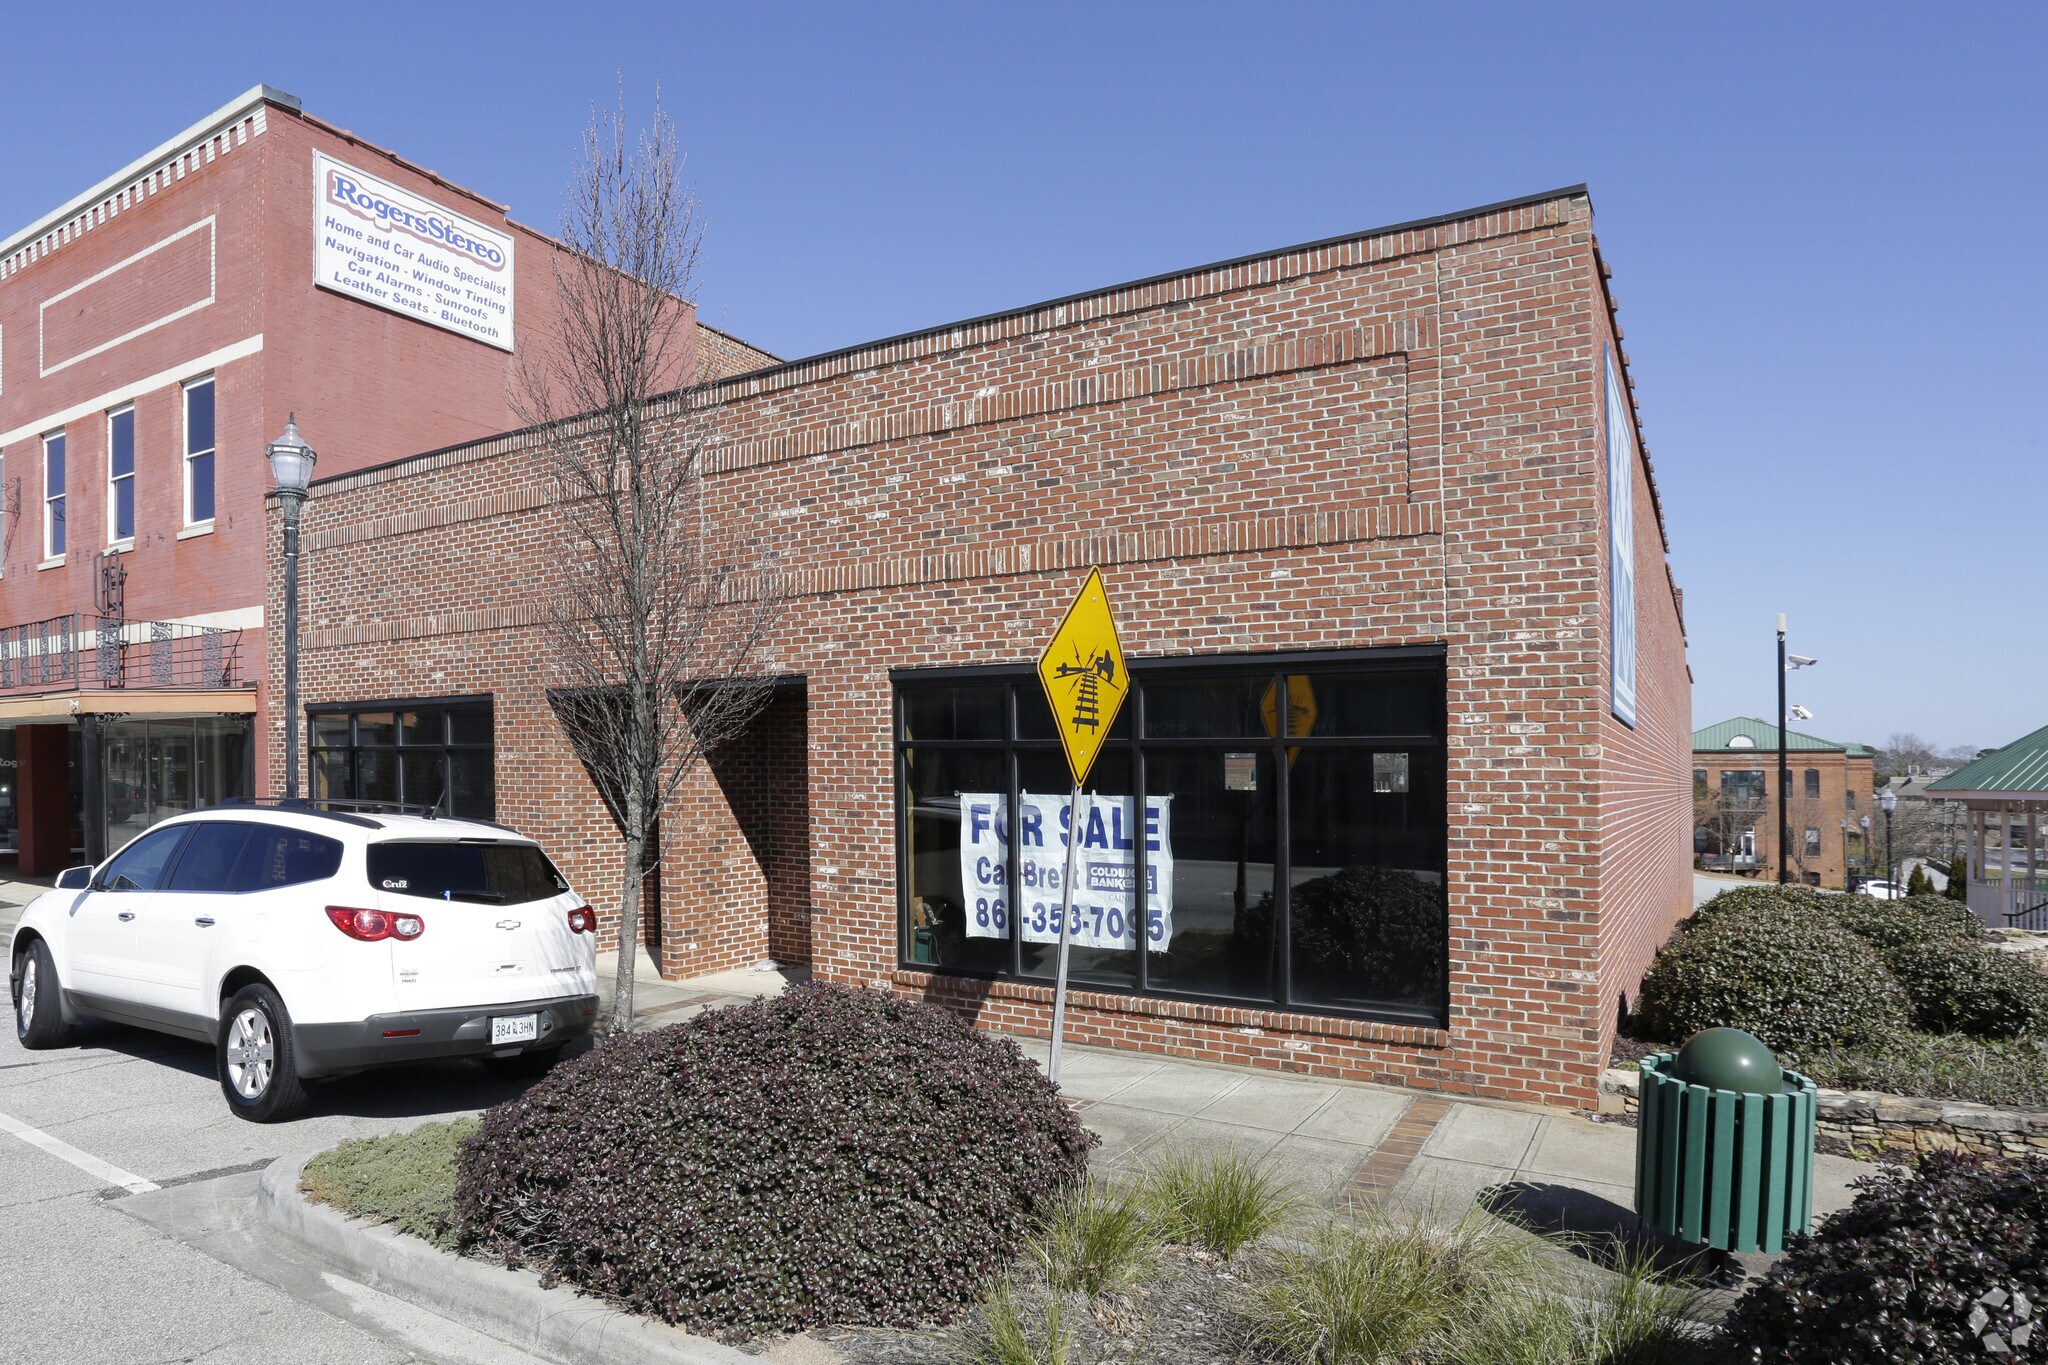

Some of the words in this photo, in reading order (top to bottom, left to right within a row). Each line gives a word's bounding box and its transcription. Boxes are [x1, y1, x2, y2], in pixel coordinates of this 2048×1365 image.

[335, 176, 502, 264] RogersStereo
[325, 216, 363, 240] Home
[367, 235, 390, 251] and
[394, 243, 414, 260] Car
[417, 253, 450, 274] Audio
[453, 266, 506, 296] Specialist
[325, 236, 400, 273] Navigation
[412, 268, 461, 296] Window
[466, 289, 506, 315] Tinting
[334, 271, 388, 299] Leather
[392, 292, 429, 314] Seats
[441, 309, 499, 338] Bluetooth
[348, 261, 372, 277] Car
[376, 272, 423, 297] Alarms
[435, 292, 488, 320] Sunroofs
[970, 803, 1044, 847] FOR
[1059, 805, 1161, 852] SALE
[976, 897, 1164, 942] 86-353-7095
